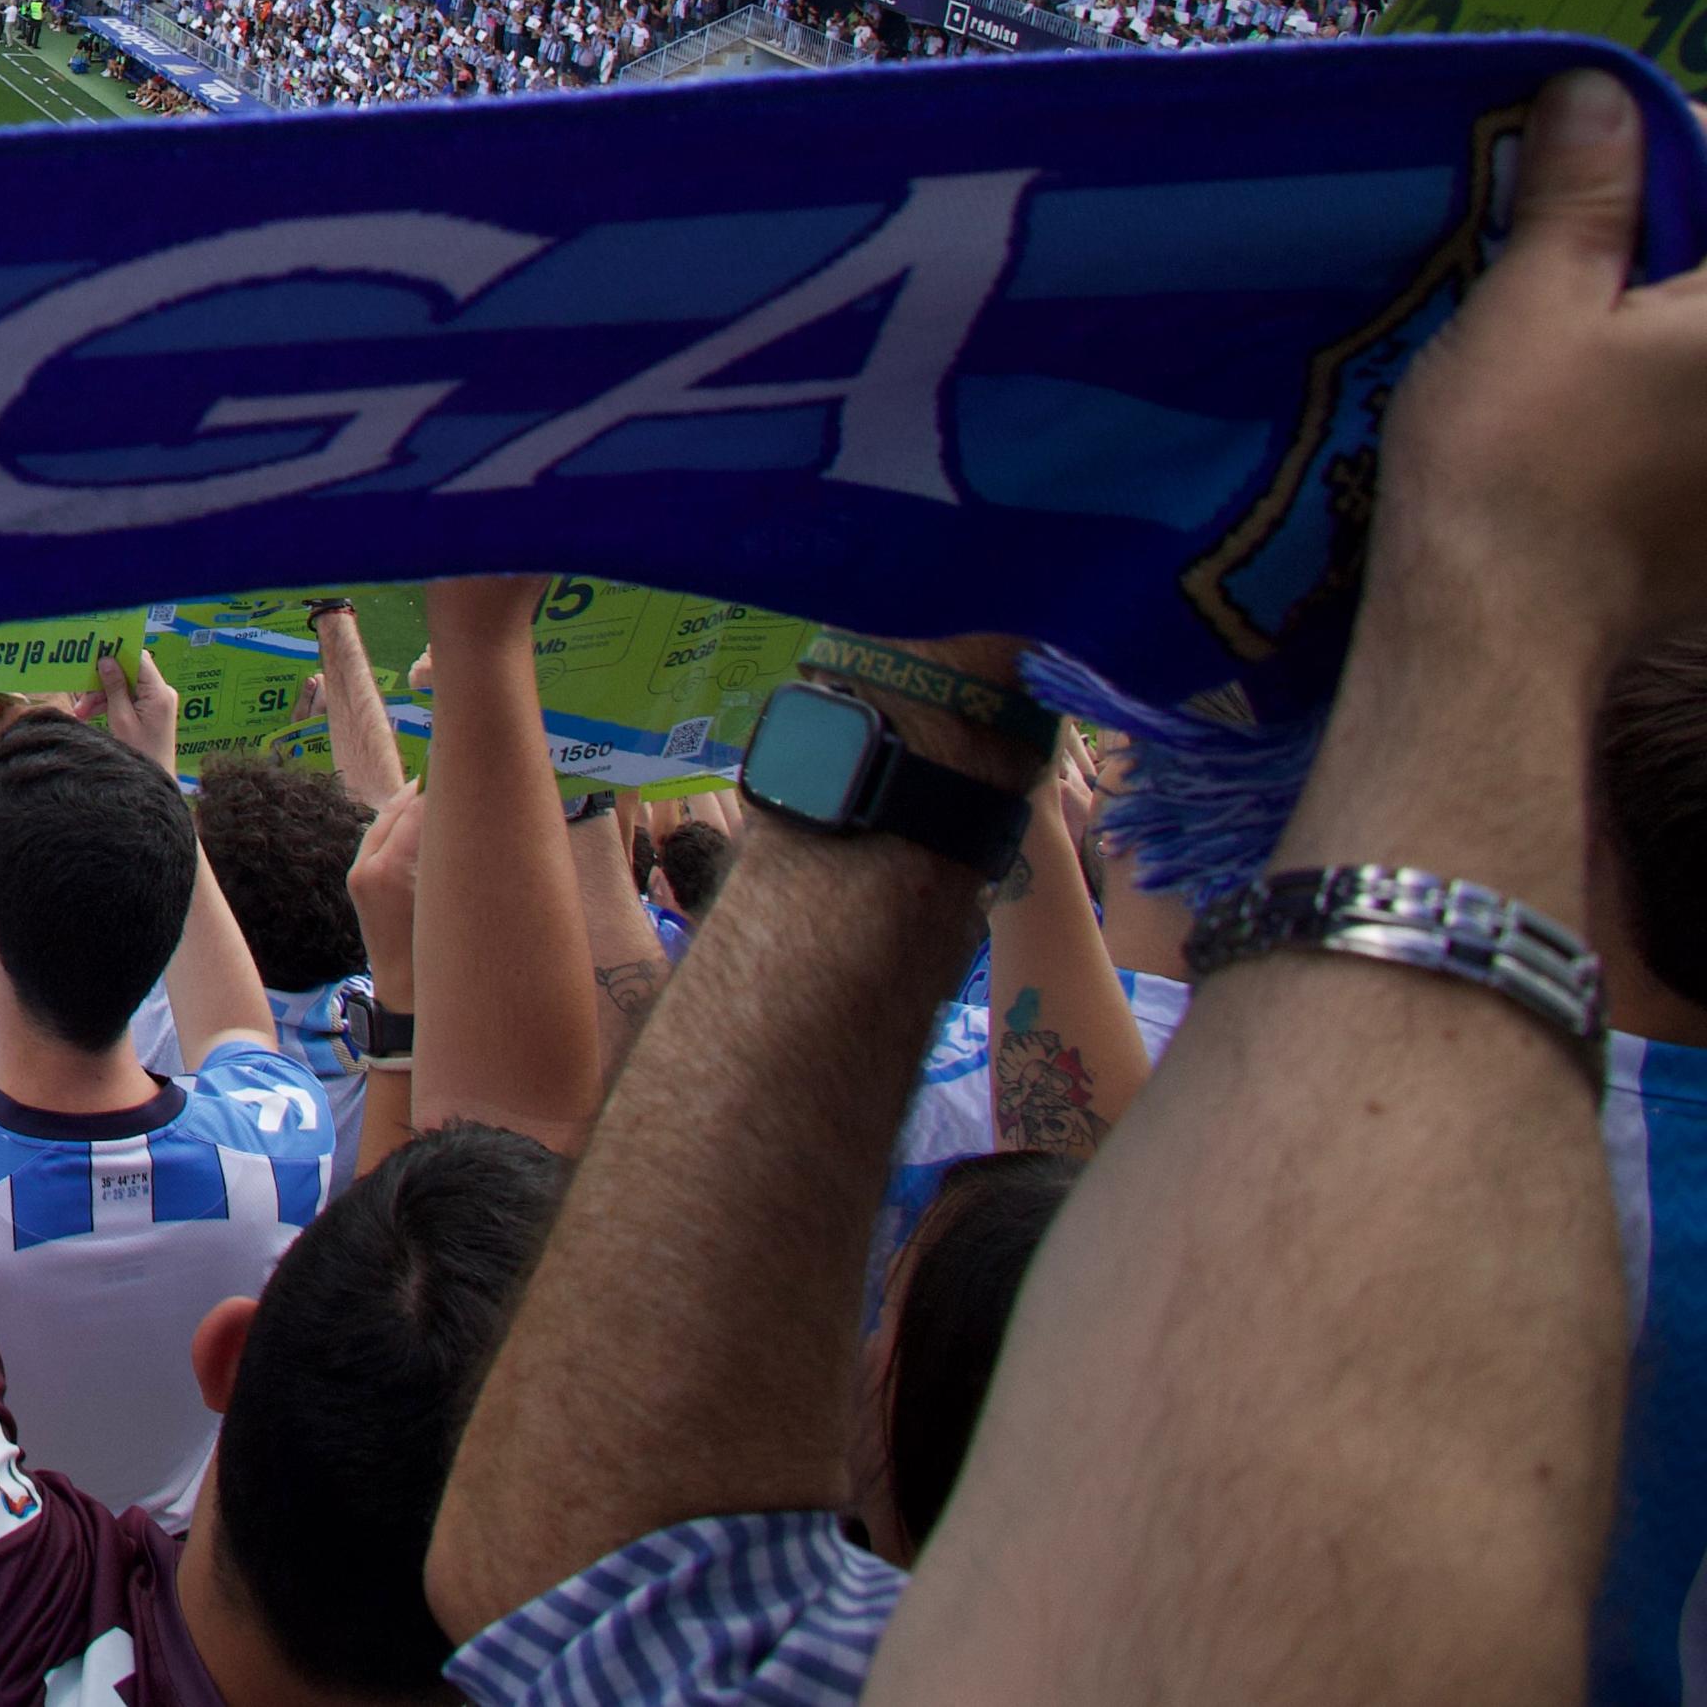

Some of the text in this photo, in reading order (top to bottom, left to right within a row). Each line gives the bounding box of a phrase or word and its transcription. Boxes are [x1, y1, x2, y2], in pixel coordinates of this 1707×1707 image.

[676, 606, 747, 637] 300Mb
[19, 639, 47, 673] el
[49, 632, 95, 664] por
[663, 638, 718, 668] 20GB
[183, 696, 214, 720] 19
[258, 687, 288, 712] 15
[559, 741, 613, 764] 1560
